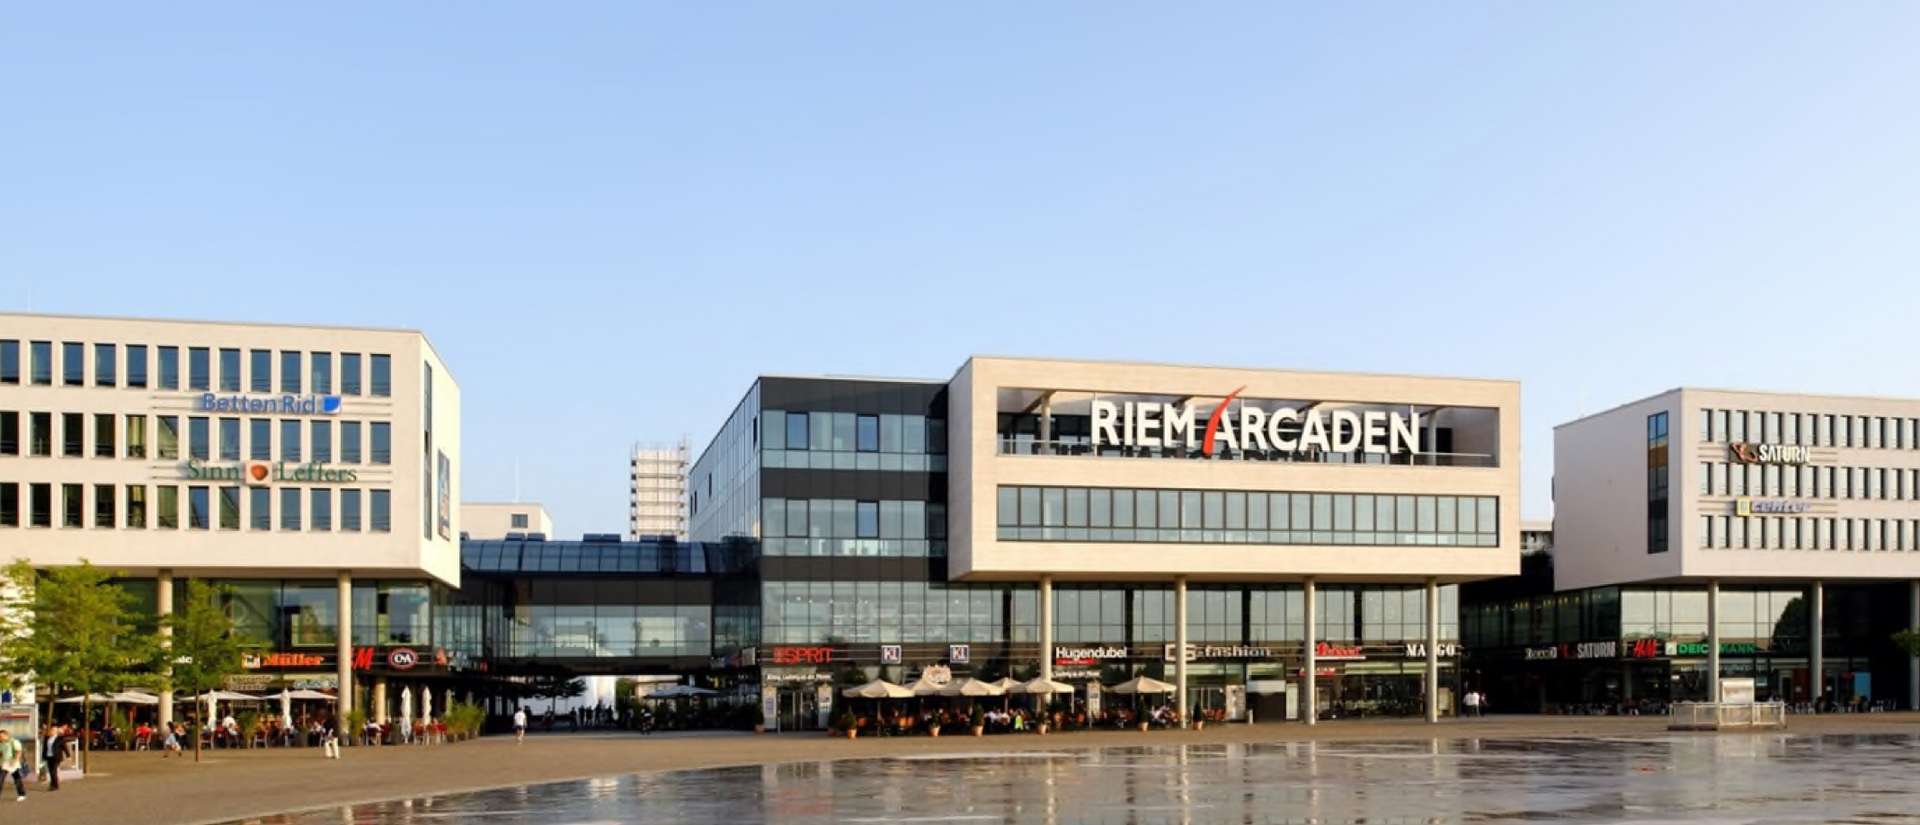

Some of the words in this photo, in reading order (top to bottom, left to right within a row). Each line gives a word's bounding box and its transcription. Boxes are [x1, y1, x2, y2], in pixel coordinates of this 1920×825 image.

[1091, 400, 1196, 448] RIEM
[1203, 391, 1420, 456] ARCADEN
[1759, 444, 1811, 463] SATURN
[187, 458, 240, 481] Sinn
[279, 461, 358, 483] Leffers
[774, 647, 833, 664] ESPRIT
[1055, 646, 1128, 661] Hugendubel
[1406, 643, 1455, 657] MAGO
[1576, 641, 1617, 658] SATURN
[1678, 643, 1755, 655] DEICMANN
